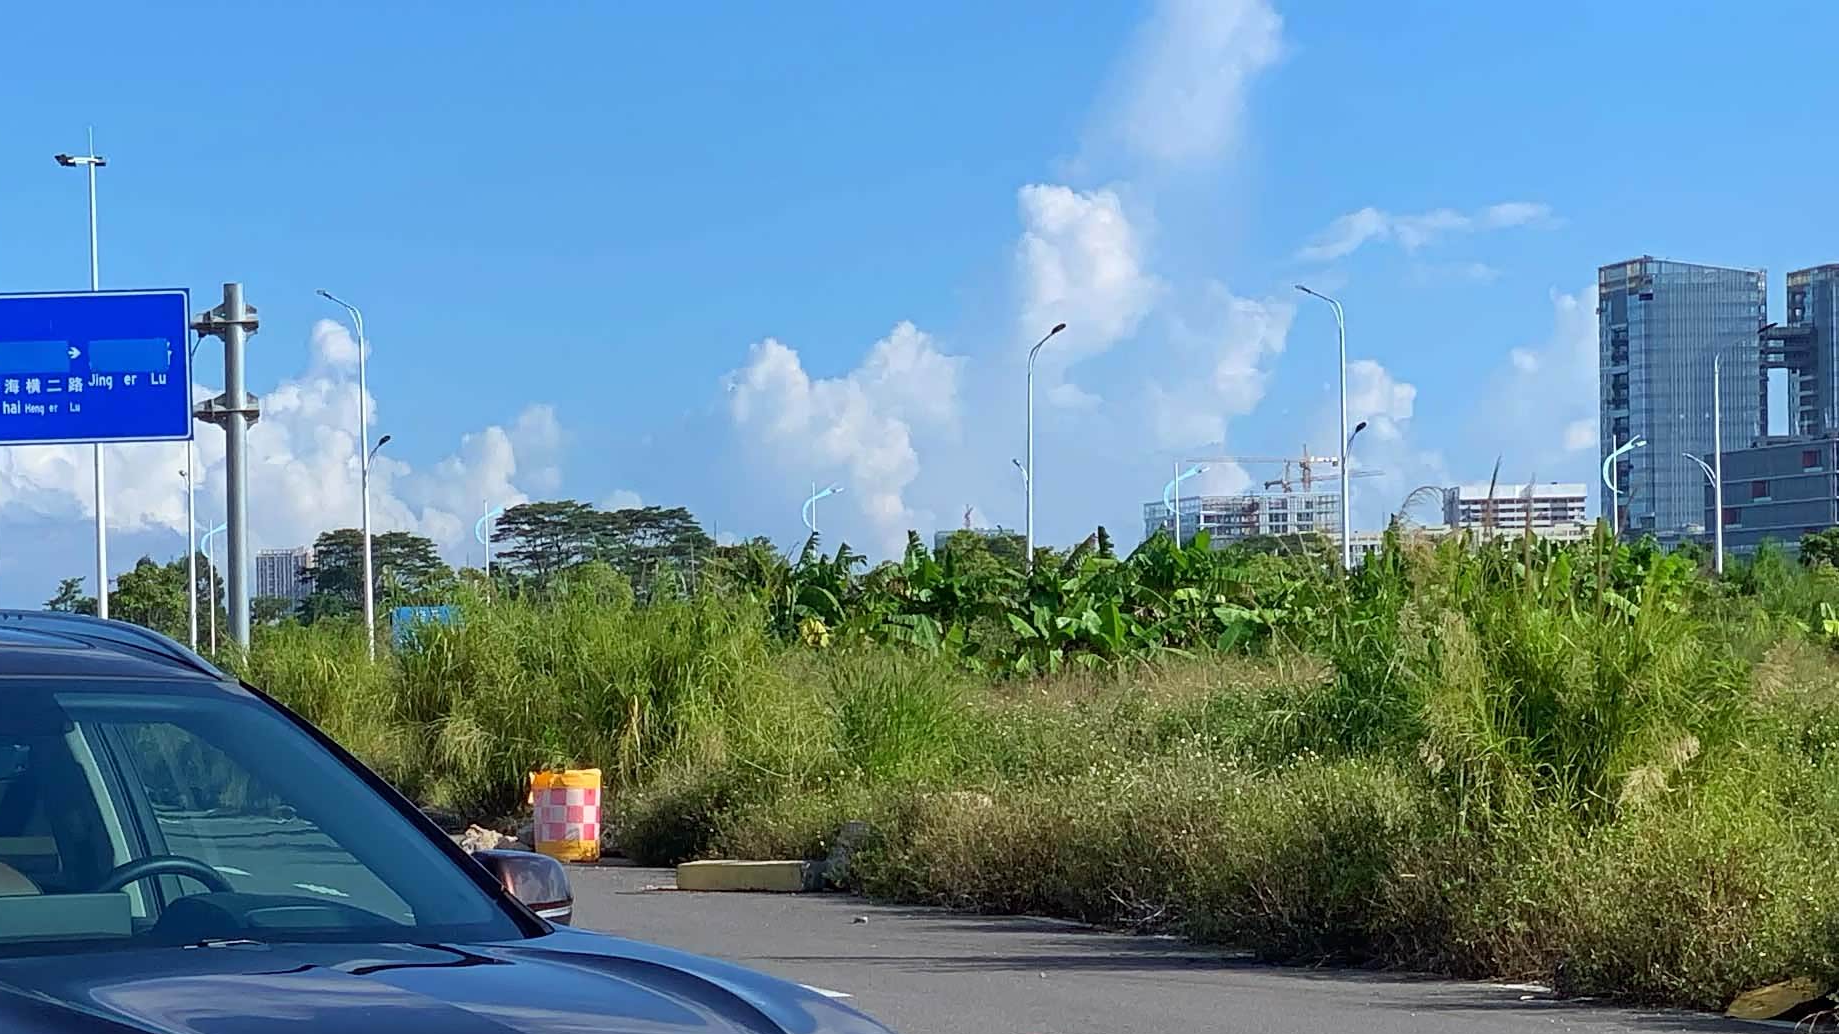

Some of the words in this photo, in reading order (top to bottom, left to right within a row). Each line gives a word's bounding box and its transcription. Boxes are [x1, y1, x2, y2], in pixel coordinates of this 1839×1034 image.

[88, 373, 113, 391] Jing
[123, 374, 137, 386] er
[150, 372, 167, 385] Lu
[2, 400, 21, 415] hai
[69, 401, 81, 413] Lu
